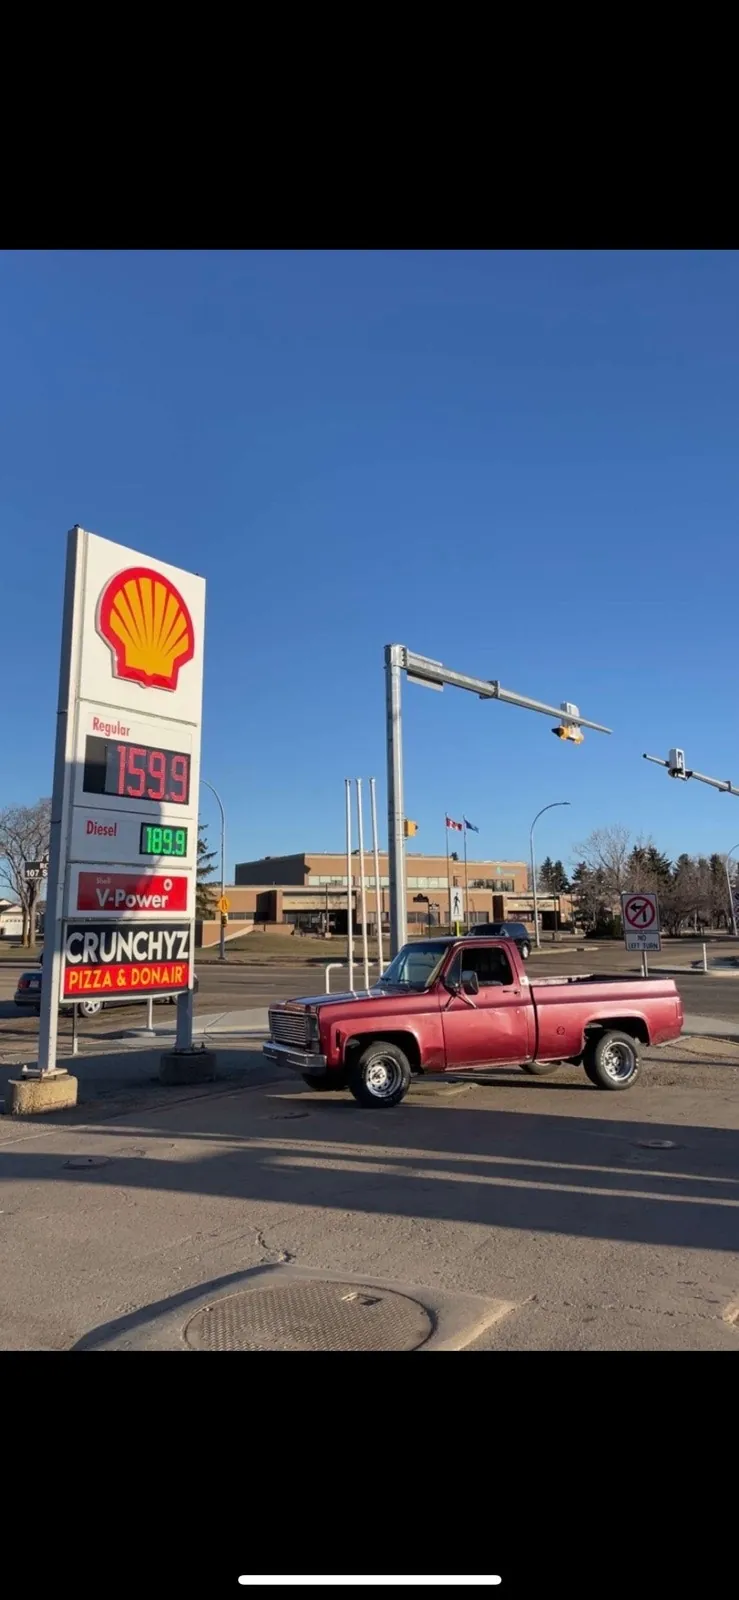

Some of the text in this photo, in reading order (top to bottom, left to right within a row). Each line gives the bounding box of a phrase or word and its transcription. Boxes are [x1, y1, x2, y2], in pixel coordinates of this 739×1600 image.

[92, 716, 131, 737] Regular
[117, 745, 188, 802] 159.9
[86, 820, 117, 837] Diesel
[146, 827, 185, 856] 189.9
[96, 876, 111, 885] Shell
[96, 888, 168, 908] V-Power
[65, 930, 189, 964] CRUNCHYZ
[69, 965, 183, 990] PIZZA & DONAIR
